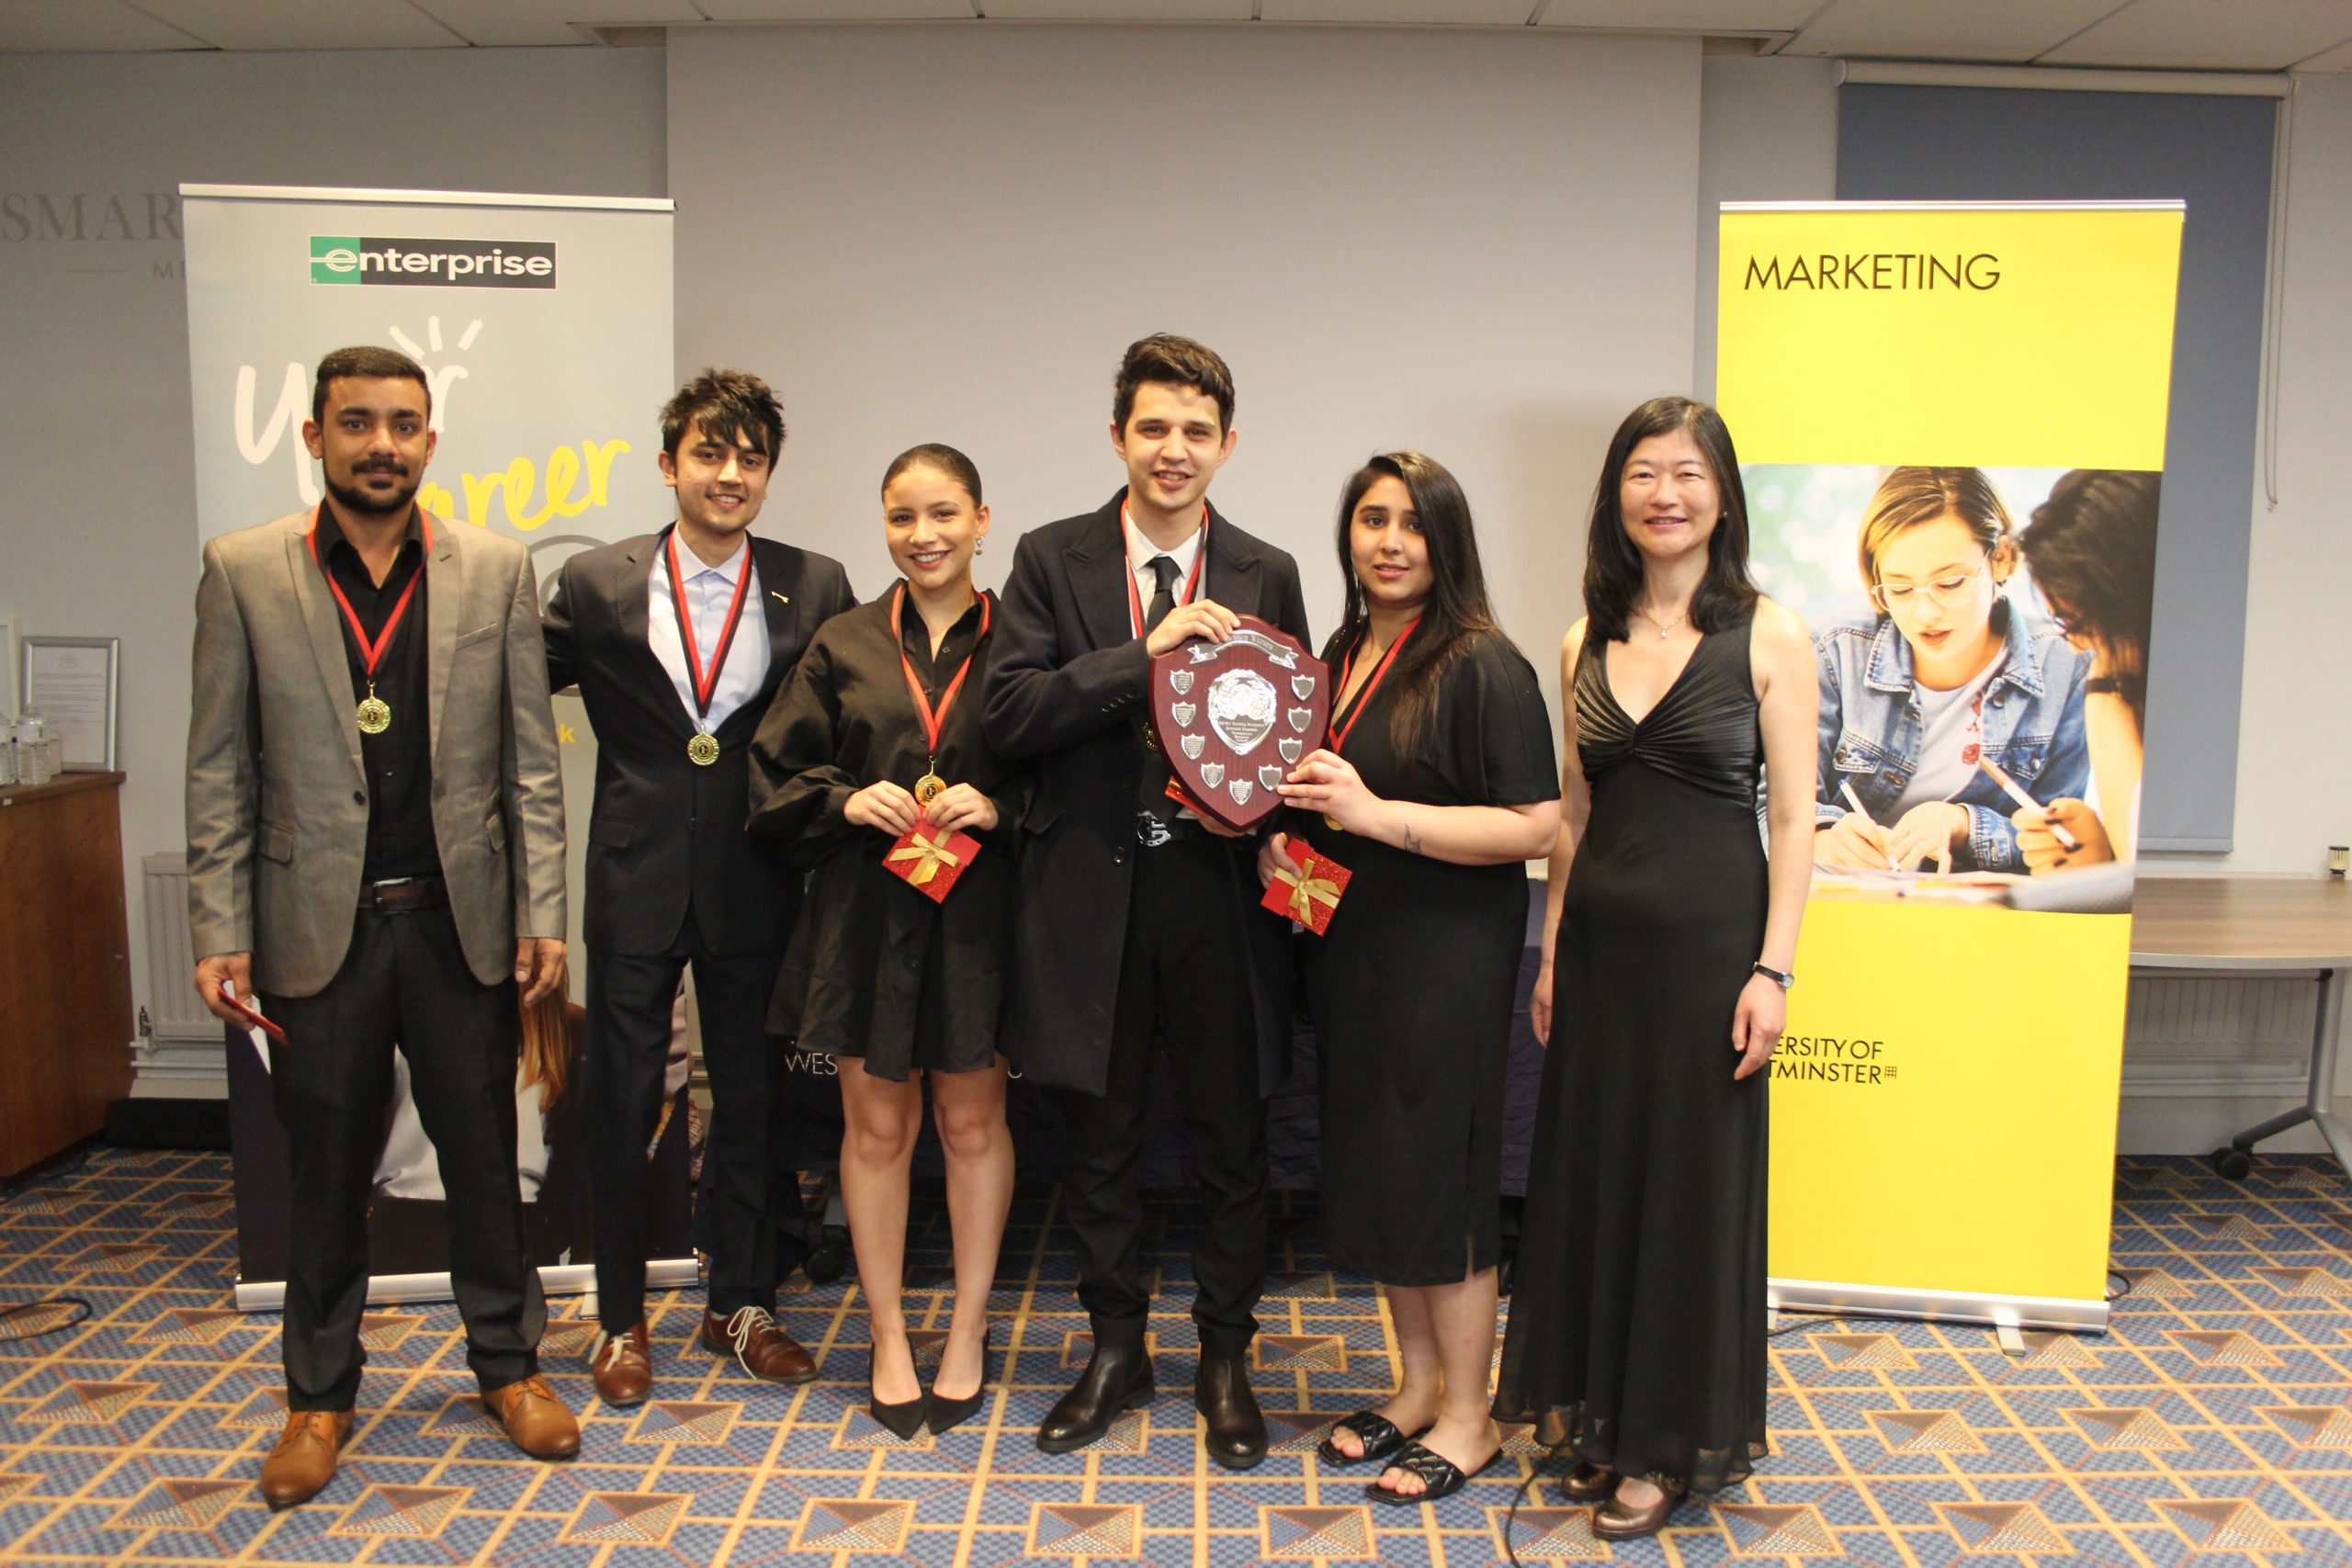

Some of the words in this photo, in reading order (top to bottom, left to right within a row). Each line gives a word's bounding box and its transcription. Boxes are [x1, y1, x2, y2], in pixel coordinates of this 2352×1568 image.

[2, 193, 184, 242] SMAR
[153, 259, 187, 280] M
[323, 248, 553, 281] enterprise
[1744, 253, 2001, 290] MARKETING
[1849, 1040, 1884, 1060] OF
